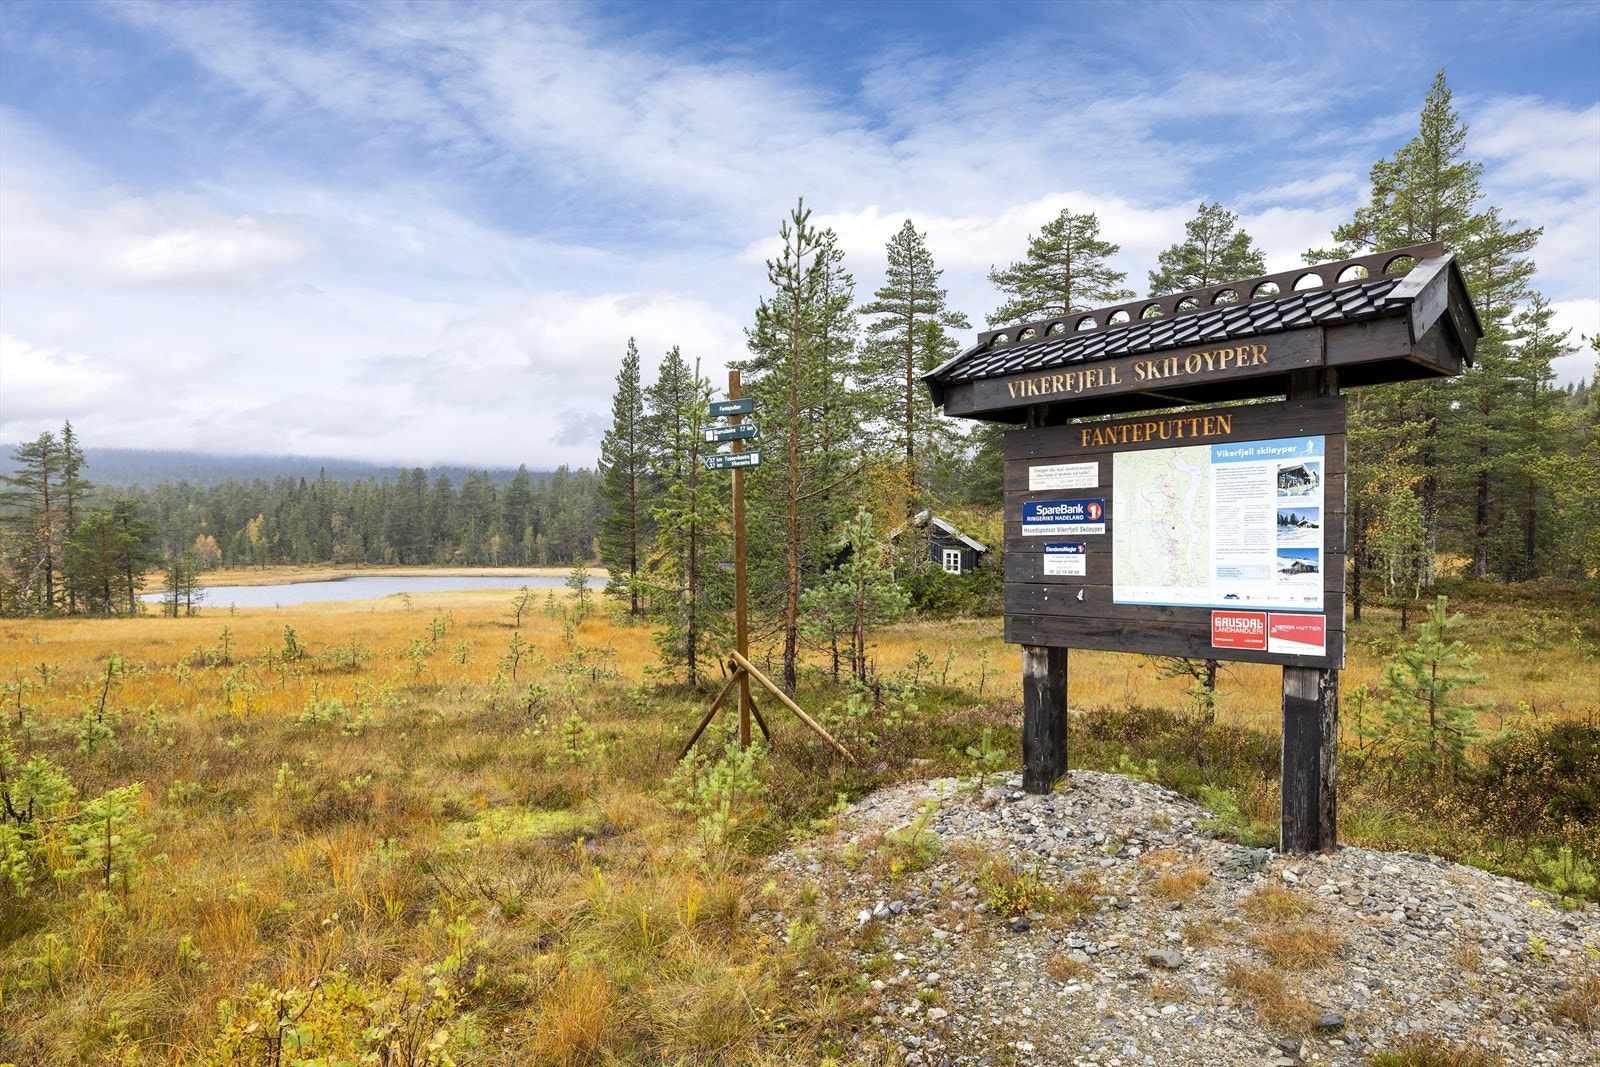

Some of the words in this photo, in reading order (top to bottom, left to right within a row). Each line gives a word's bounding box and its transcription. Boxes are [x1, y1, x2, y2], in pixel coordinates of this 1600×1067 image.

[1007, 365, 1122, 400] VIKERFJELL
[1133, 343, 1269, 382] SKILØYPER
[1081, 414, 1233, 447] FANTEPUTTEN
[1216, 447, 1254, 458] Vikerfjell
[1256, 445, 1297, 455] skiløyper
[1036, 504, 1084, 517] SpareBank
[1215, 617, 1264, 628] GAUSDAL
[1214, 626, 1264, 634] LANDHANDLERI
